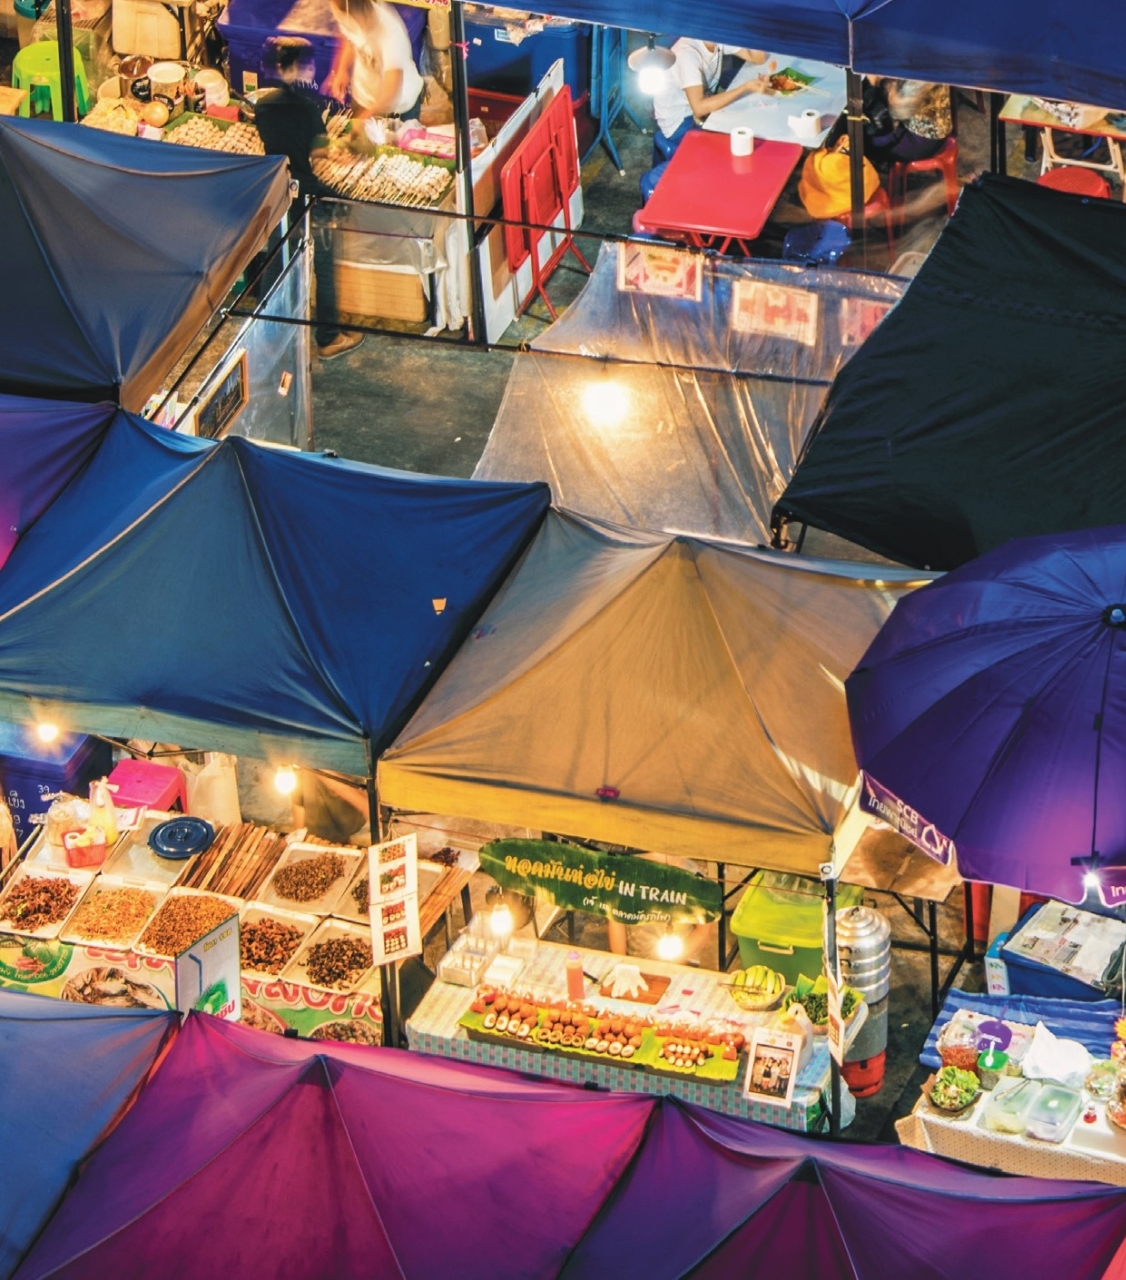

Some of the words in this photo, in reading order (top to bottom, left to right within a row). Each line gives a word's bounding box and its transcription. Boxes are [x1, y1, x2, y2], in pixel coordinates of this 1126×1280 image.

[897, 799, 919, 825] SCB
[618, 880, 635, 898] IN
[639, 885, 688, 906] TRAIN
